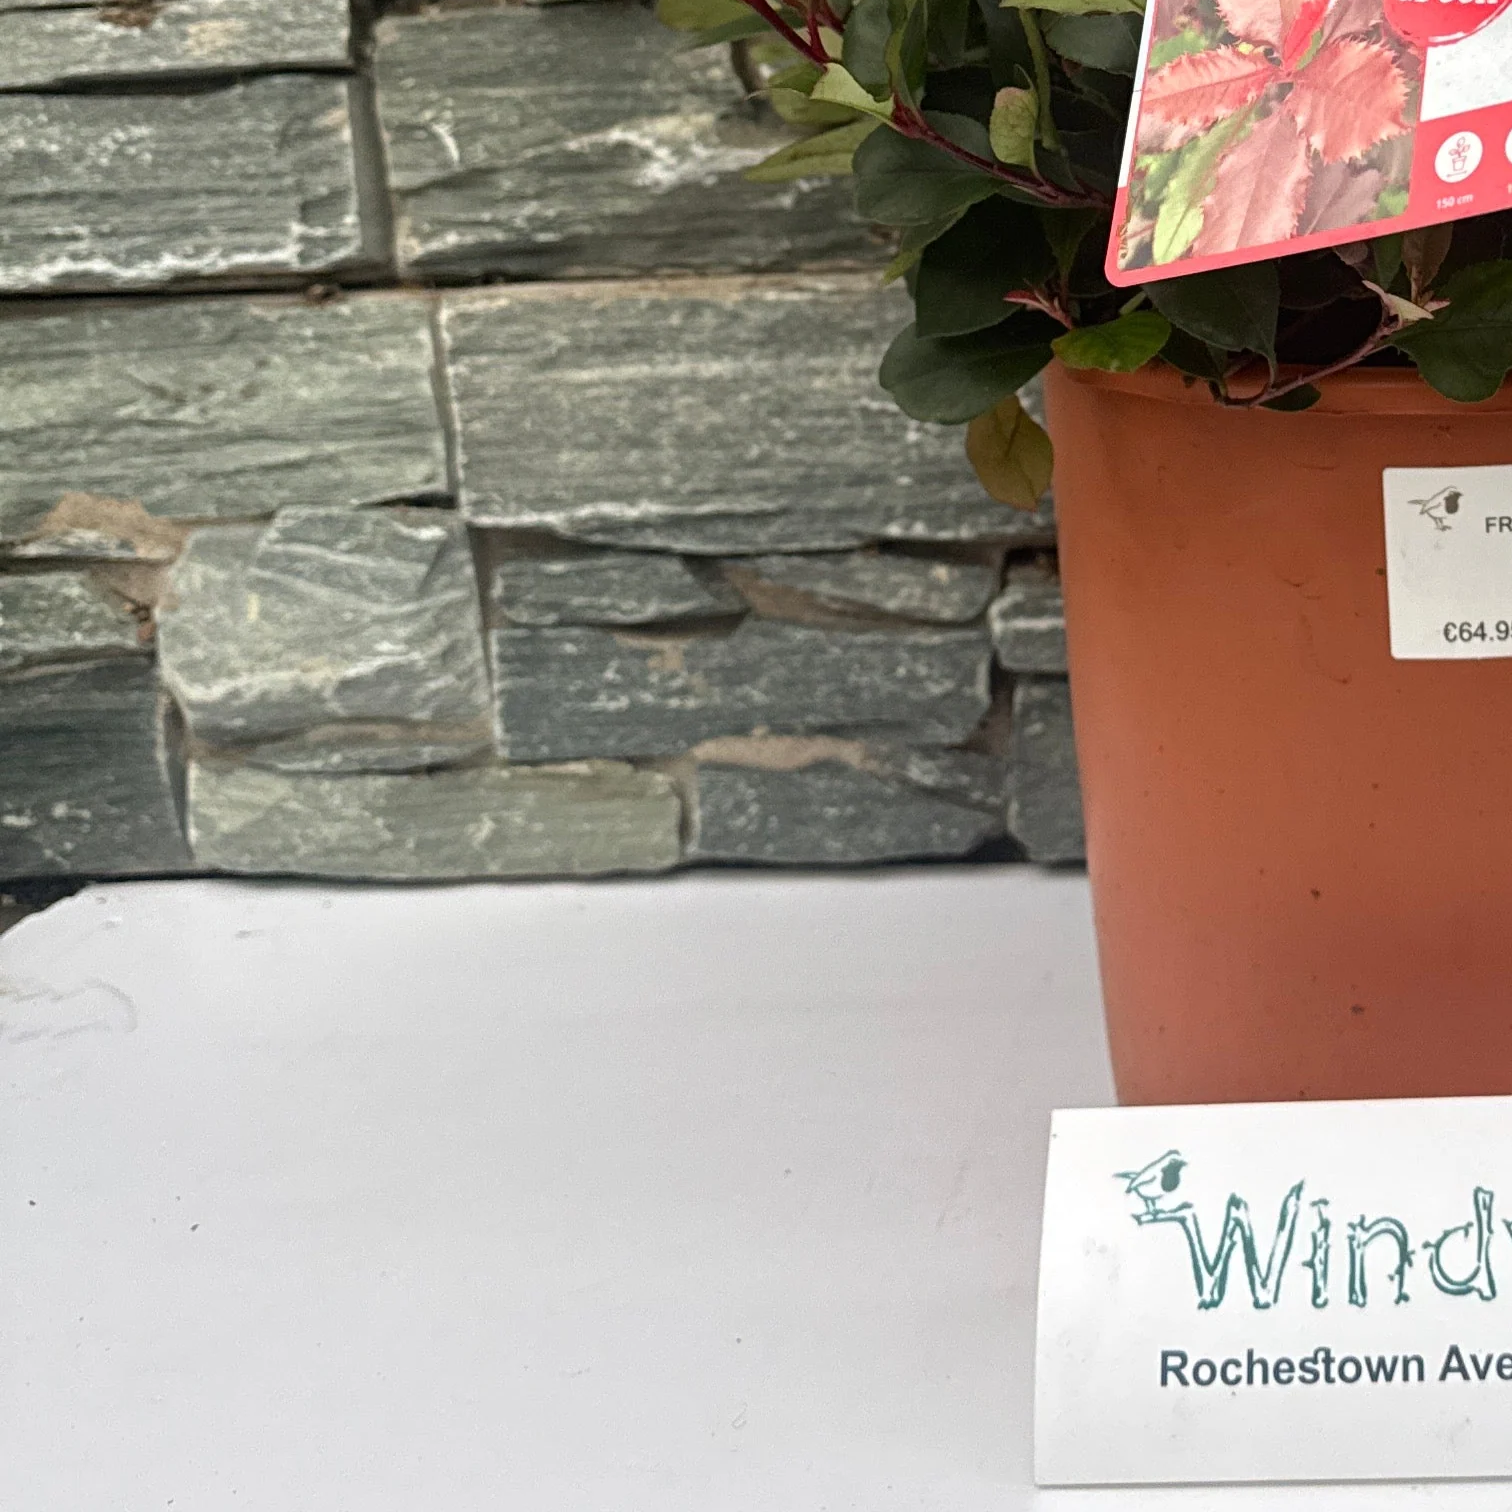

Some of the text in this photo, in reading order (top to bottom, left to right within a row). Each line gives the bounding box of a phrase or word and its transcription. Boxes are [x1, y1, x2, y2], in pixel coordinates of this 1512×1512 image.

[1436, 193, 1474, 210] 150 cm
[1160, 1345, 1425, 1387] Rochestown
